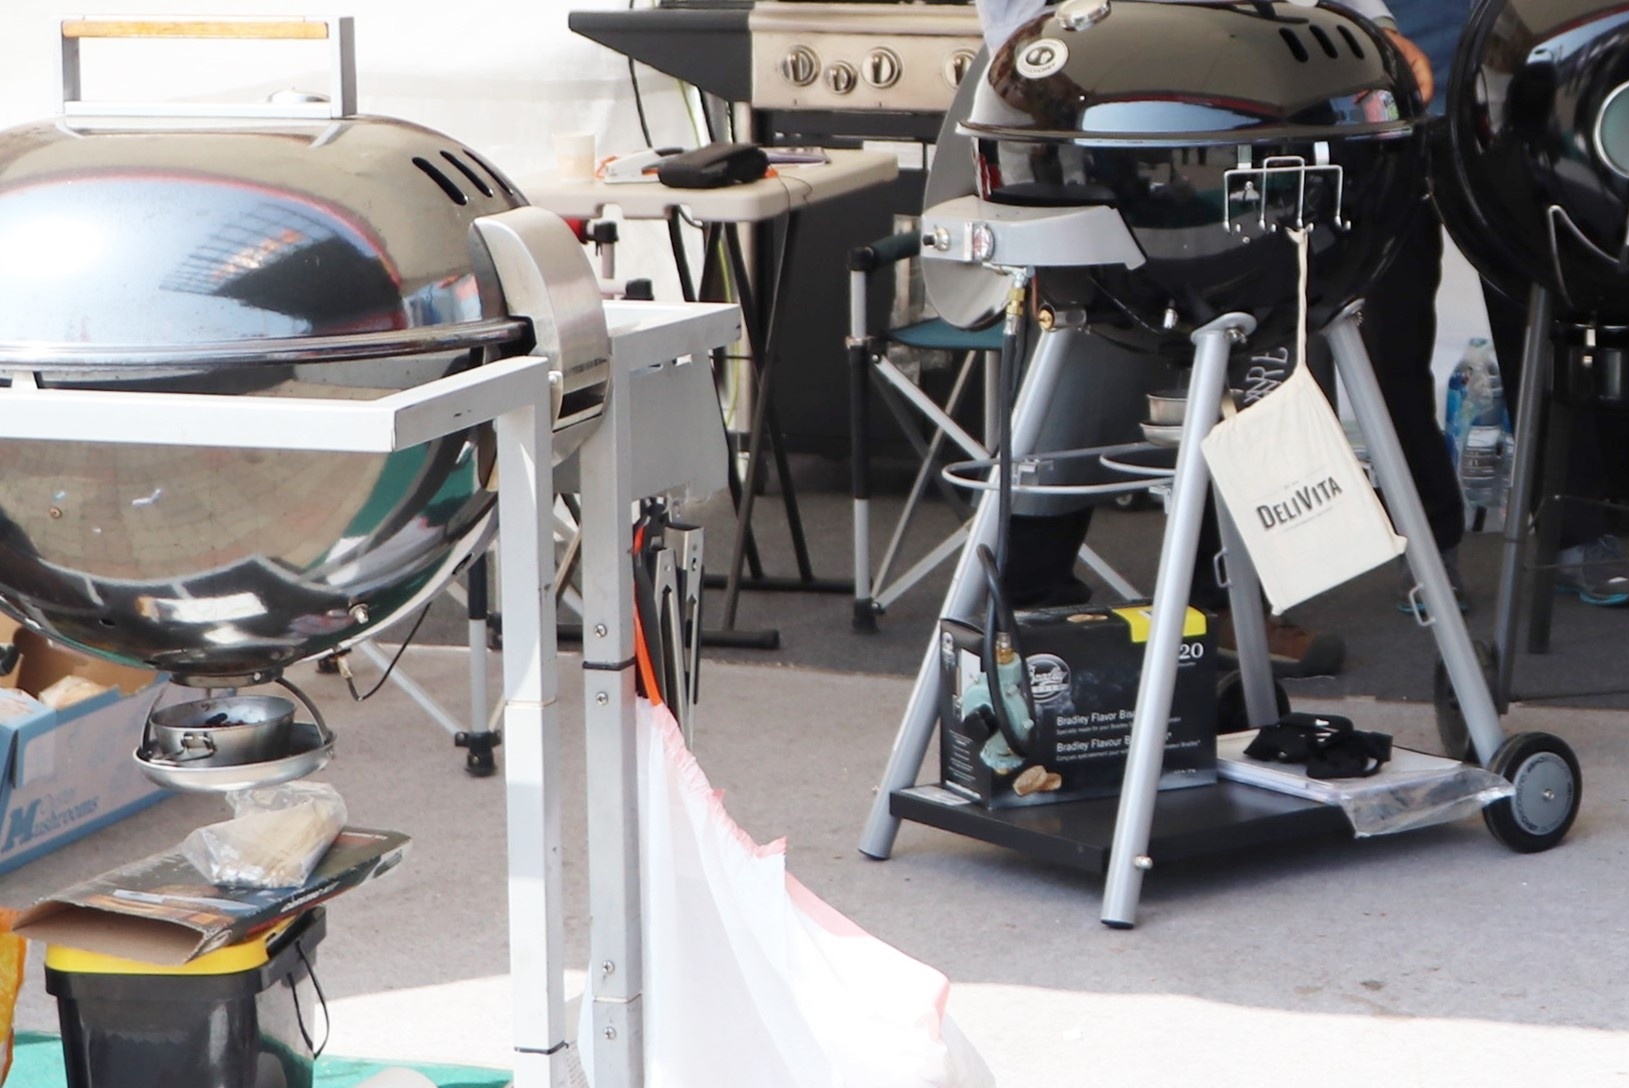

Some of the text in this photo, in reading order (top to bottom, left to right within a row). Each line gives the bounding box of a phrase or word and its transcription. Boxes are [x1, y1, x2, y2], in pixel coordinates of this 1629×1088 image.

[1056, 715, 1089, 726] Bradley
[1091, 712, 1117, 723] Flavor
[1056, 741, 1089, 752] Bradley
[1091, 738, 1122, 748] Flavour
